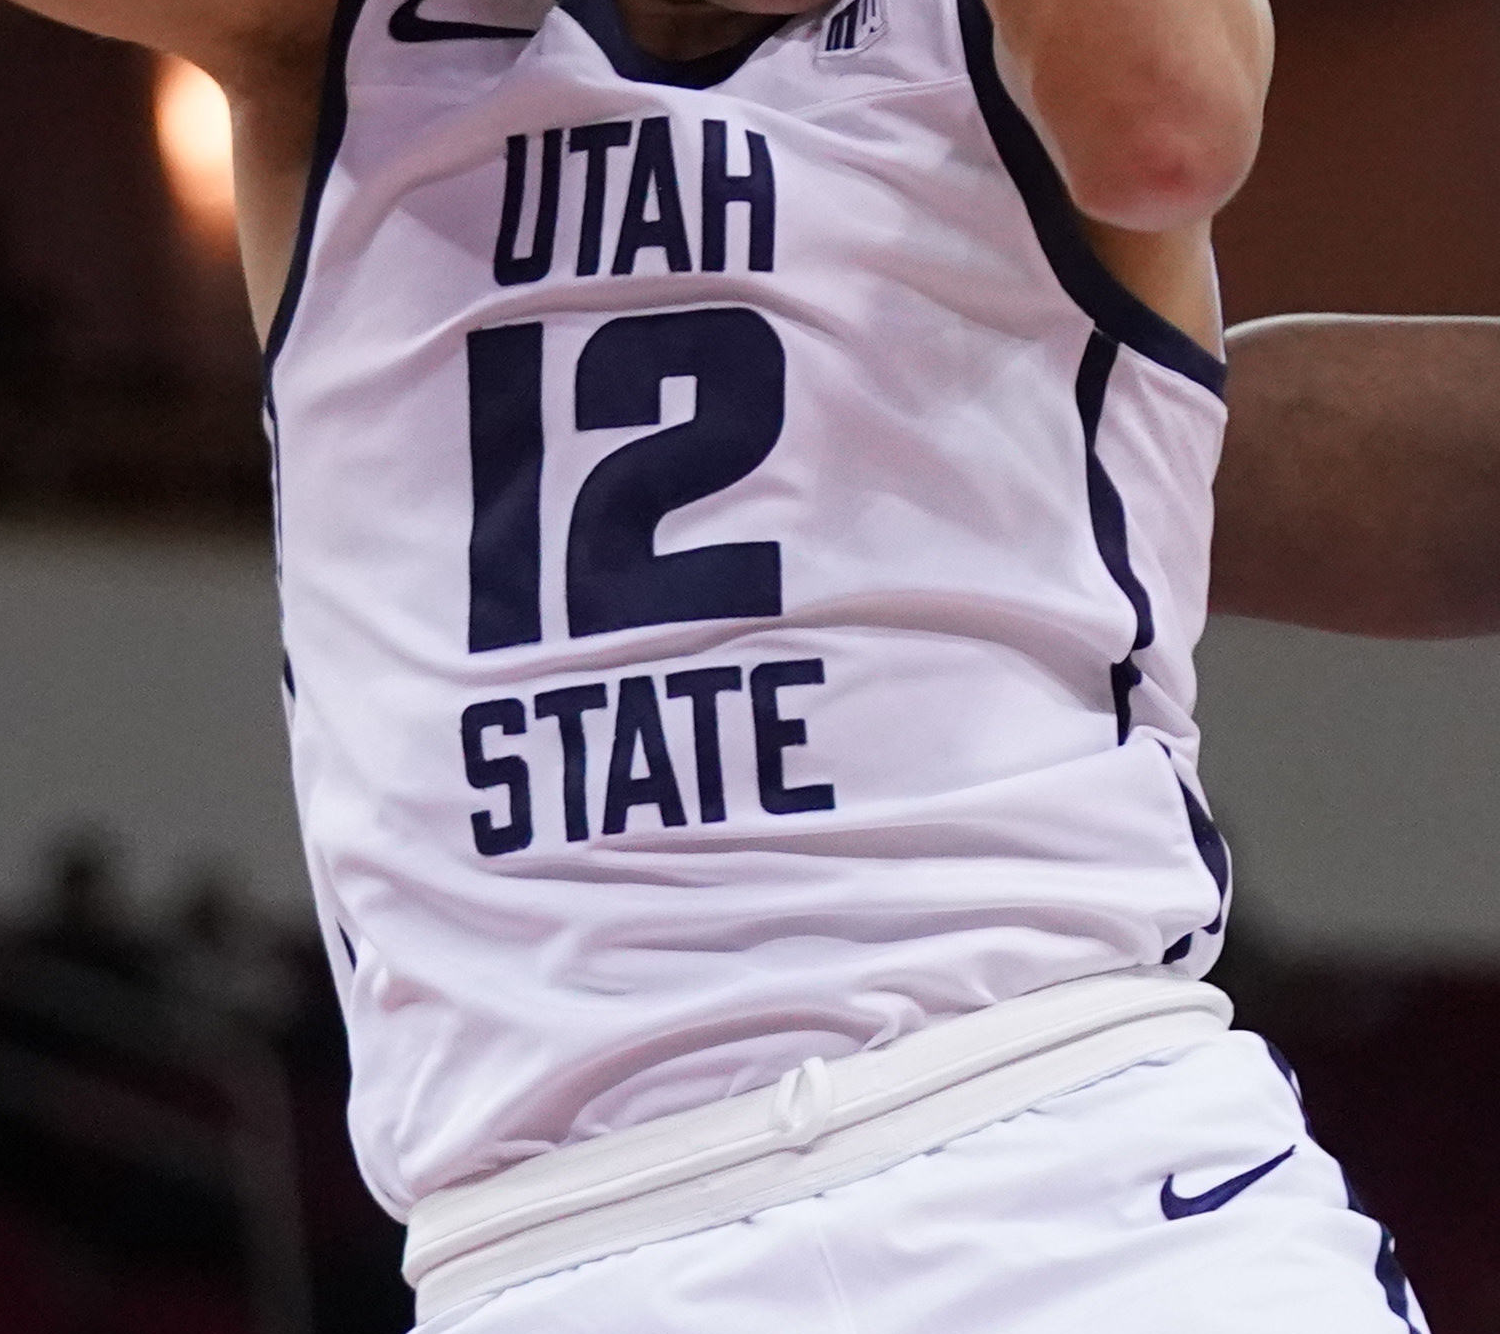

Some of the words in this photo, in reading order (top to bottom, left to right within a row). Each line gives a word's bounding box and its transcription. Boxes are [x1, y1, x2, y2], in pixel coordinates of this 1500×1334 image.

[493, 116, 776, 286] UTAH
[466, 306, 786, 653] 12
[461, 657, 836, 856] STATE
